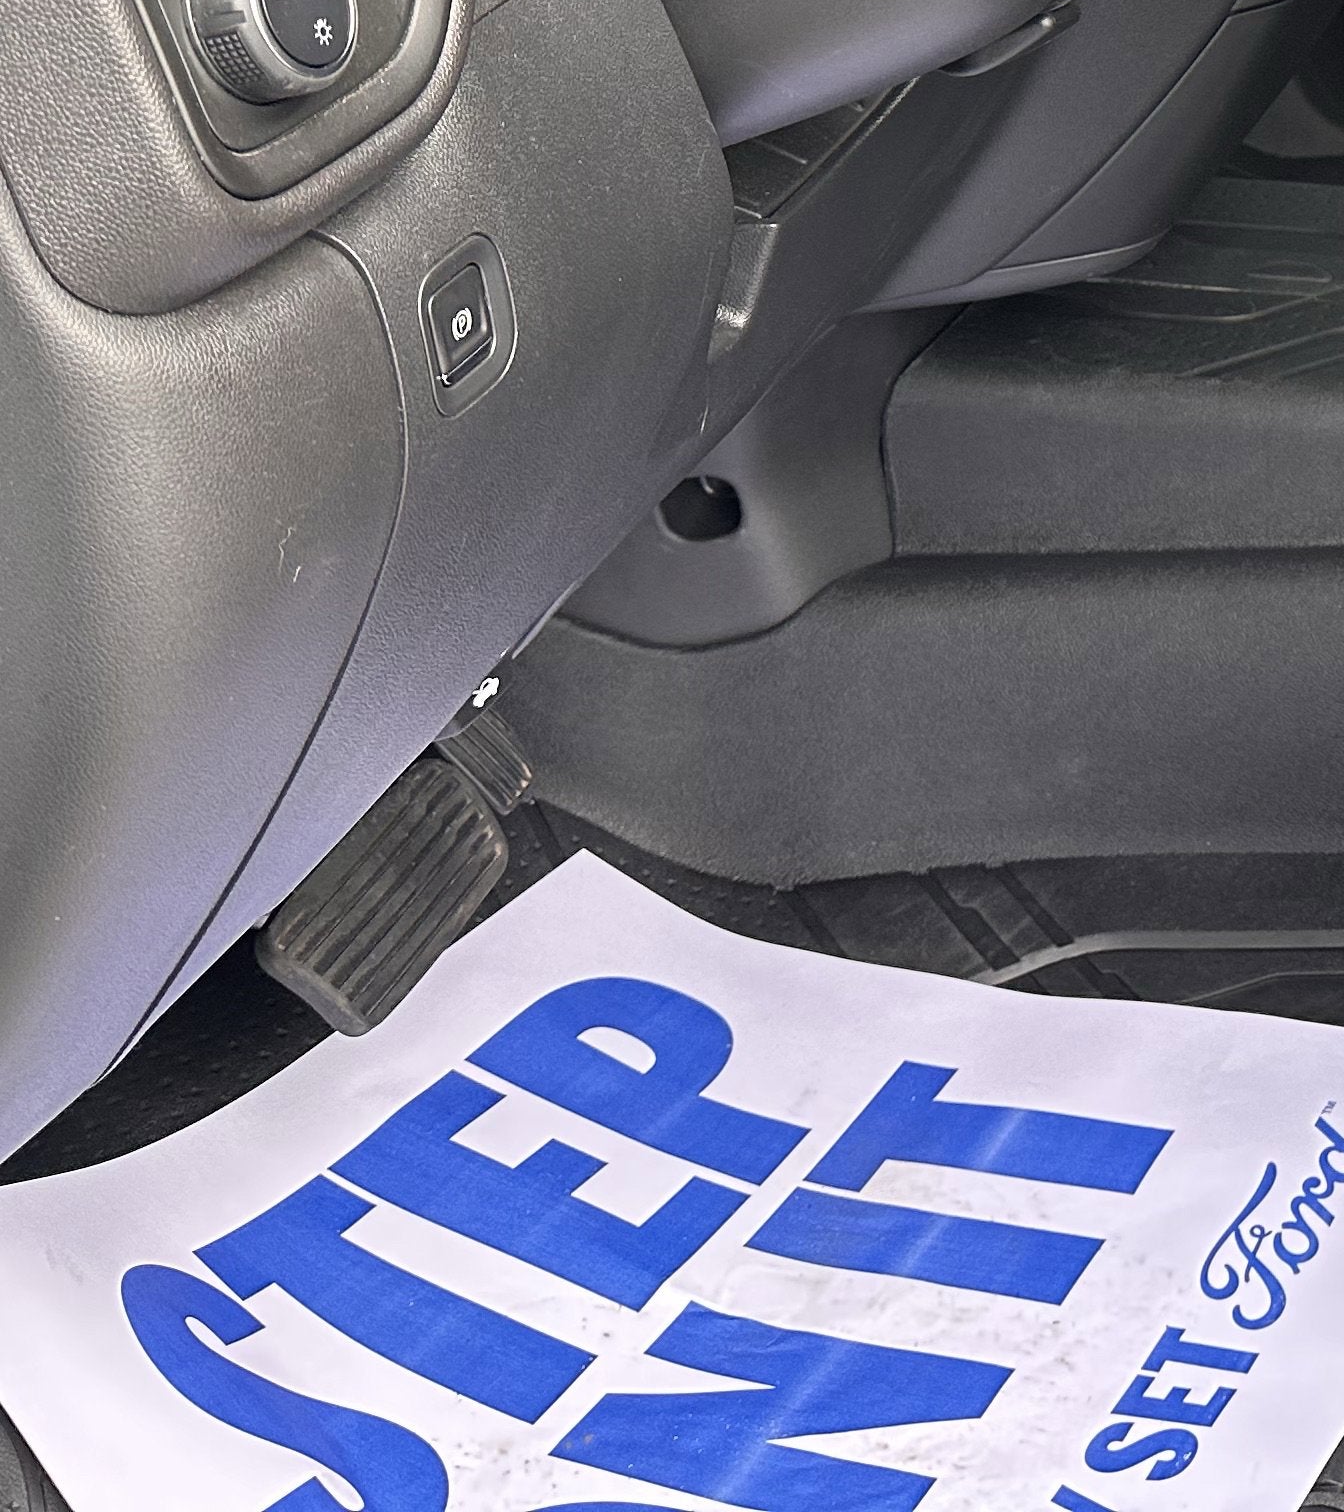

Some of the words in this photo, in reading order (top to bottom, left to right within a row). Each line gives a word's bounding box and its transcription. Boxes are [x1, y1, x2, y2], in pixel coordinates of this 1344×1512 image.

[121, 976, 812, 1512] STEP
[743, 1060, 1174, 1306] IT
[1084, 1325, 1259, 1481] SET
